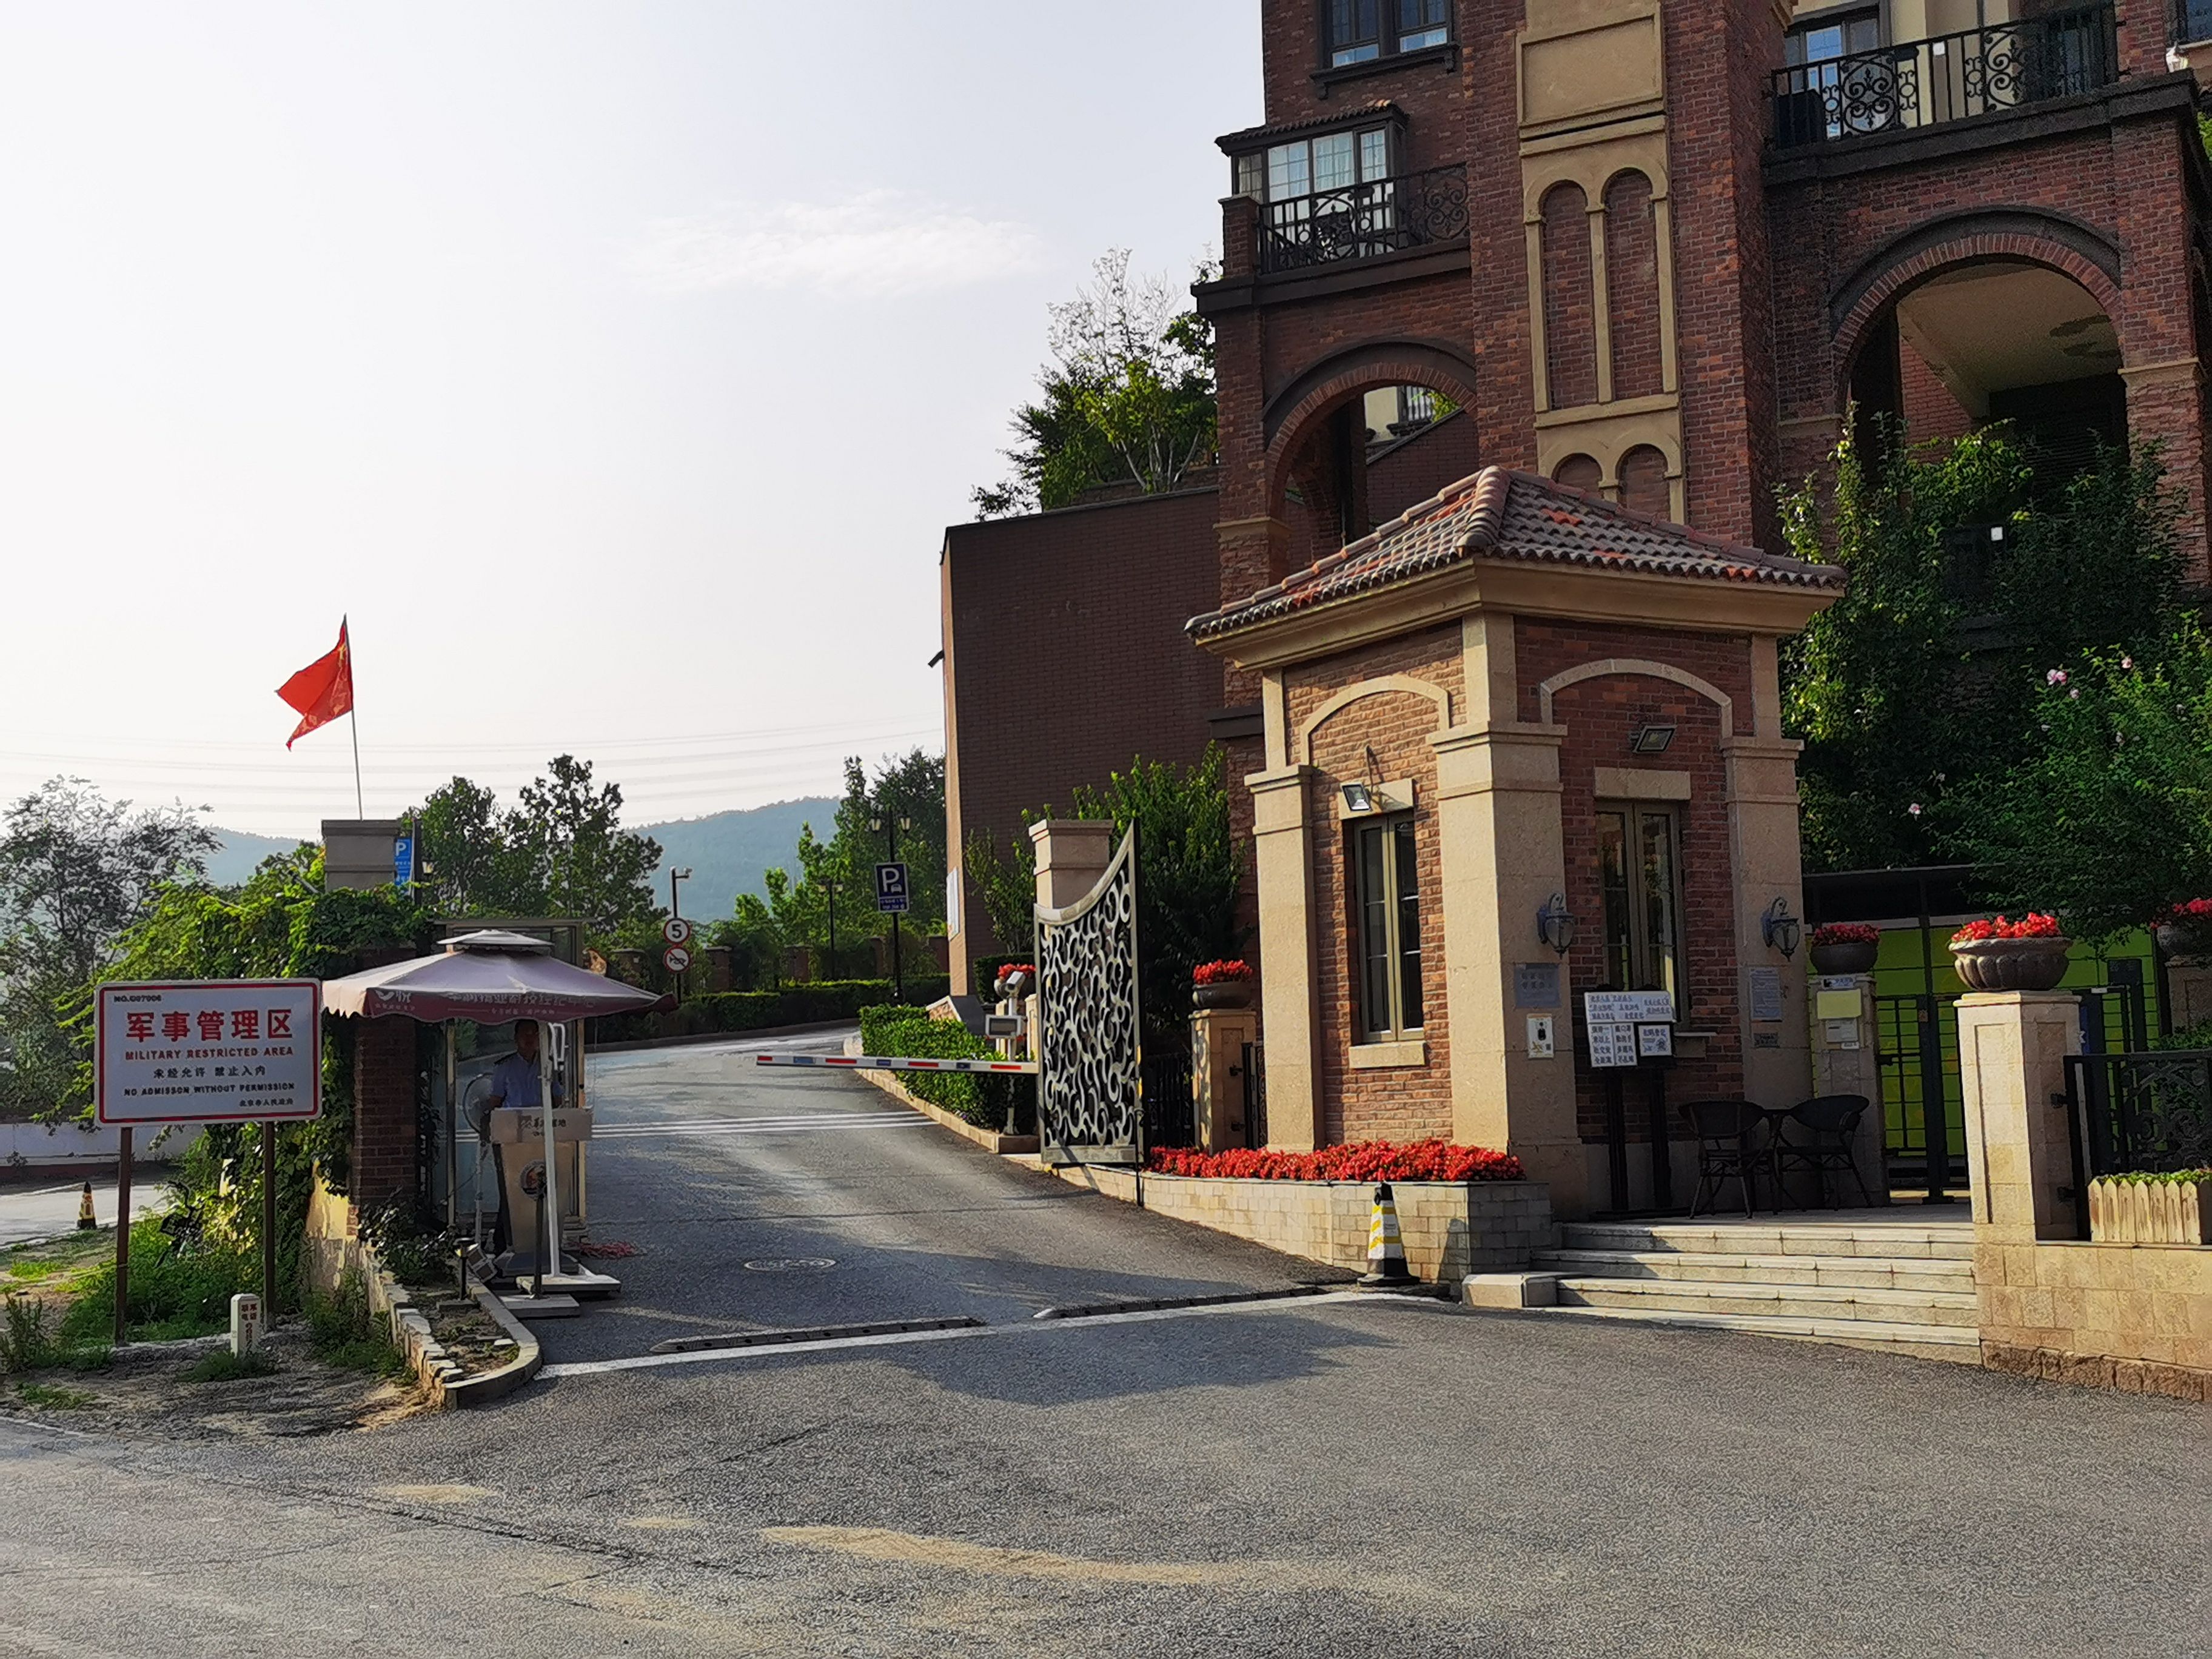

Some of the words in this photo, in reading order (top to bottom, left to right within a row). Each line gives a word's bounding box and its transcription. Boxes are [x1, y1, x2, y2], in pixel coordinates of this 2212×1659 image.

[395, 842, 407, 856] P
[882, 867, 900, 893] P
[672, 923, 682, 939] 5
[126, 1009, 292, 1042] 军事管理区
[126, 1050, 181, 1060] MILITARY
[187, 1048, 258, 1058] RESTRICTED
[264, 1047, 293, 1056] AREA
[154, 1067, 205, 1079] 未经允许
[215, 1065, 265, 1076] 禁止入内
[240, 1083, 294, 1091] PERMISSION
